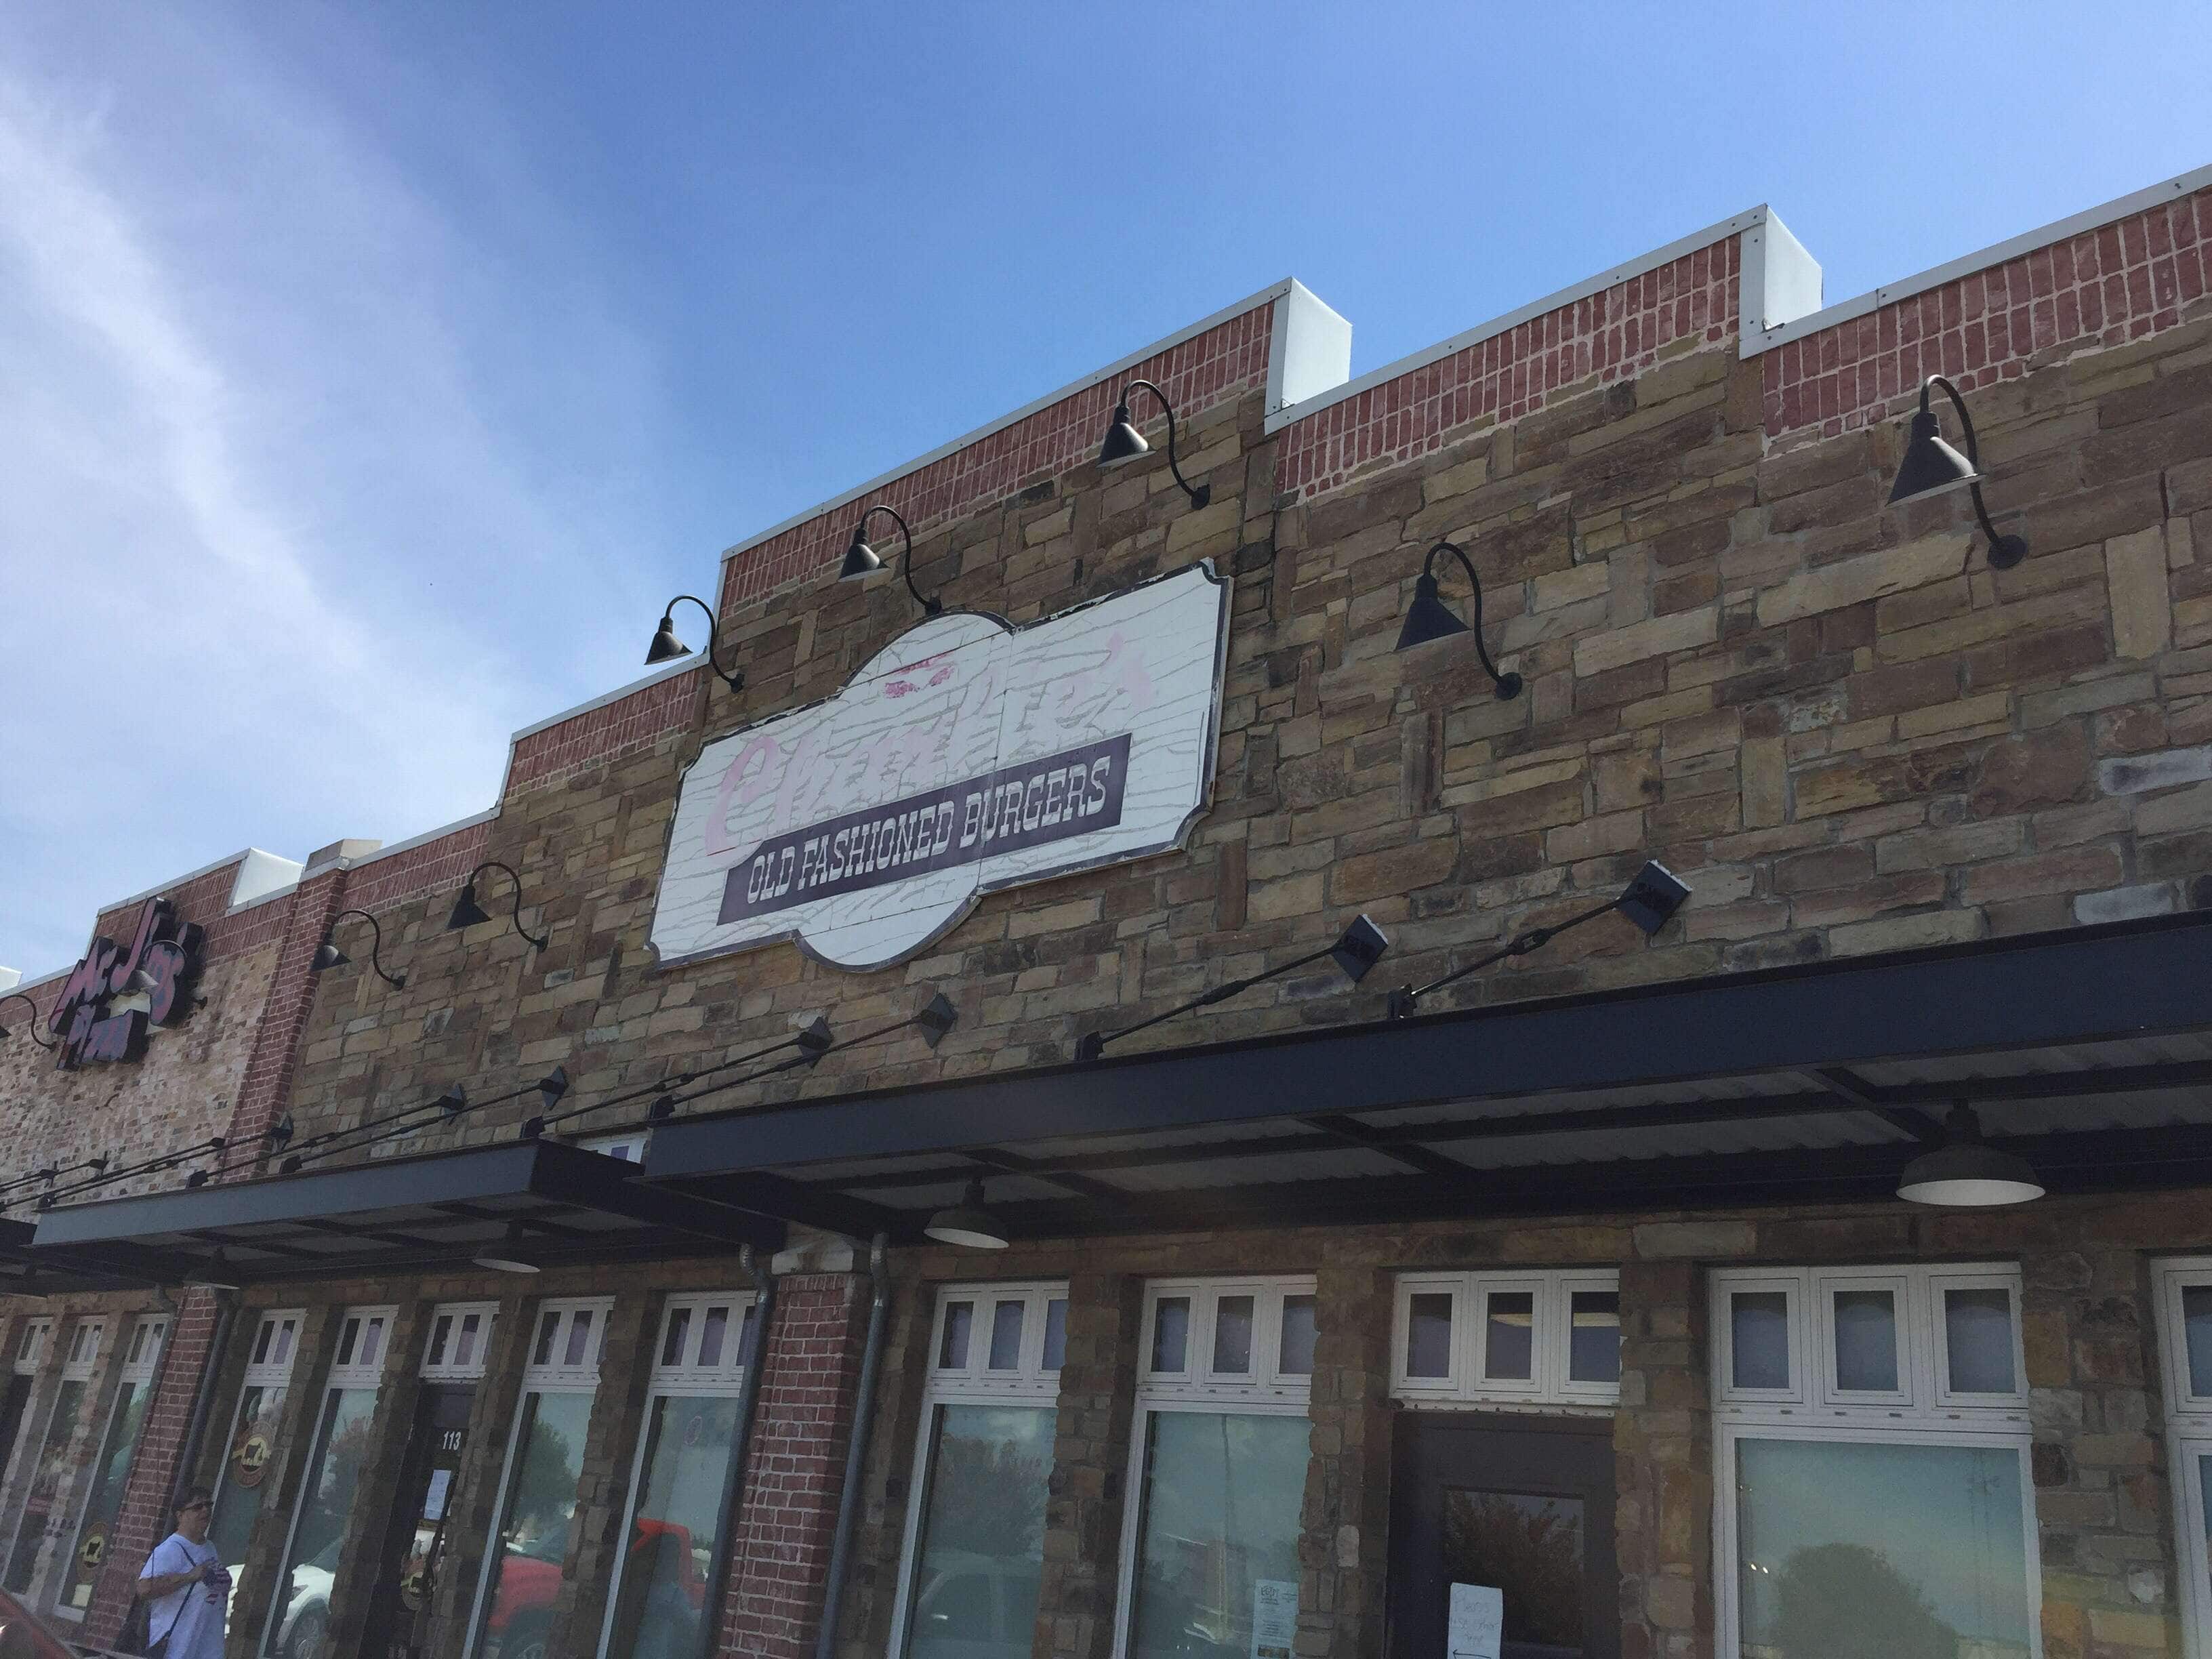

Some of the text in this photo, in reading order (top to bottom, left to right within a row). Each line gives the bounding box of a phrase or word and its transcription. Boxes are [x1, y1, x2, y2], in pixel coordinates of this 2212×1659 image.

[747, 755, 1111, 905] OLD FASHIONED BURGERS
[442, 1431, 462, 1451] 113
